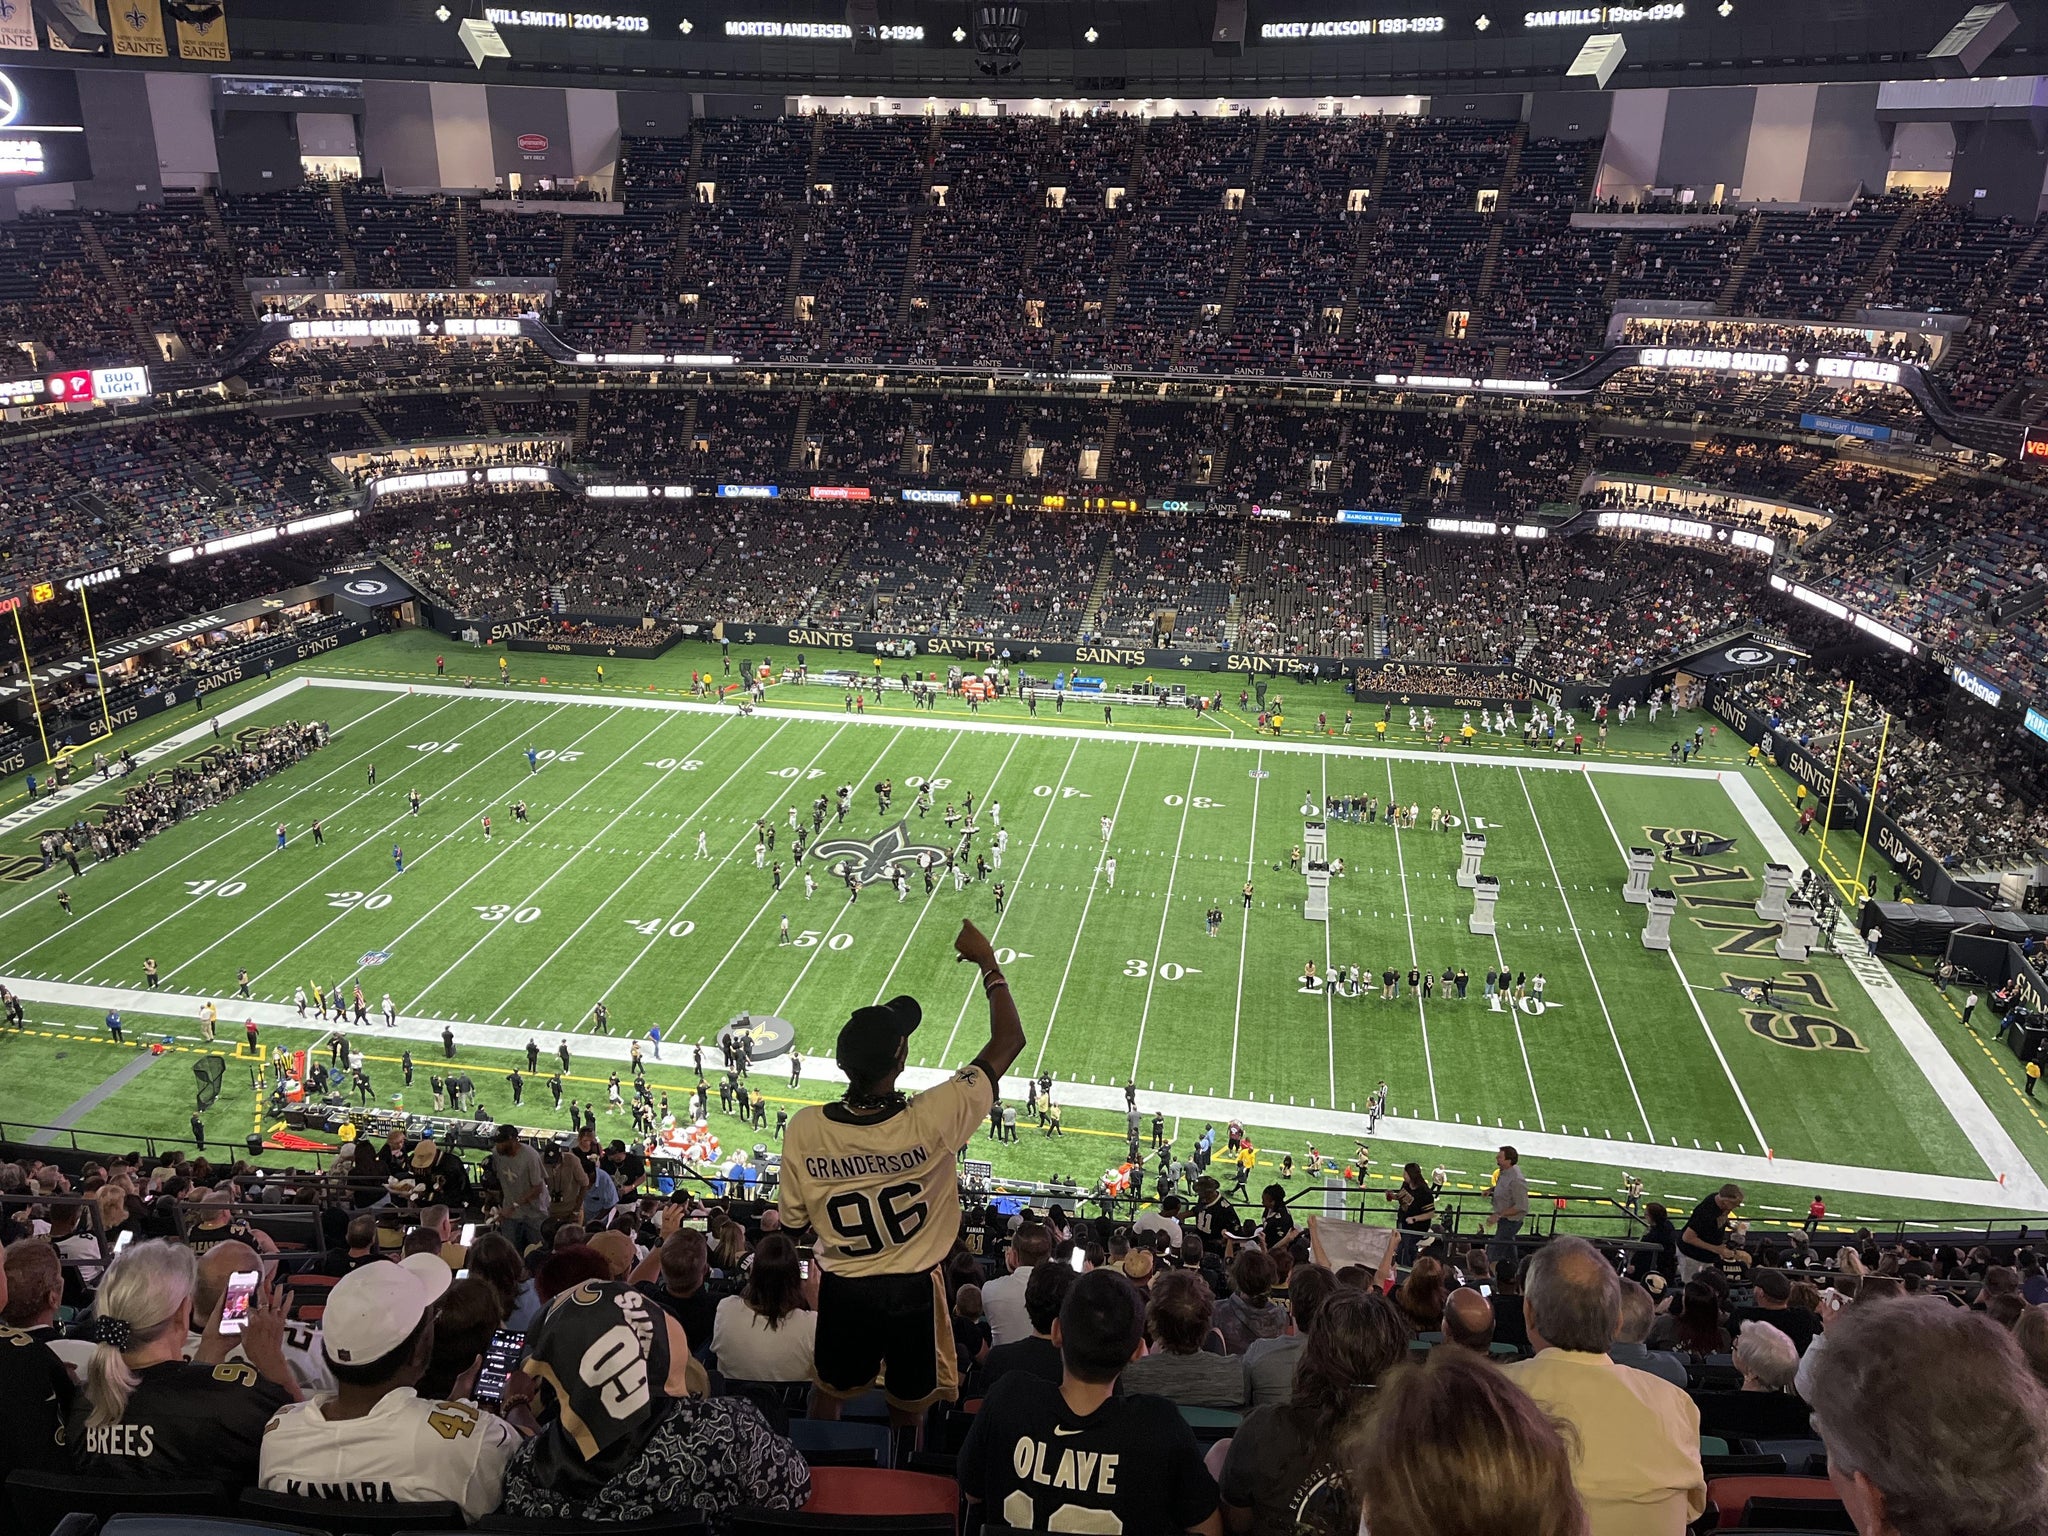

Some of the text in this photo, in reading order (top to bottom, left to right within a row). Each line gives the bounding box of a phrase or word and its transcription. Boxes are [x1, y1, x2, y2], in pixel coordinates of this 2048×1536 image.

[485, 8, 649, 31] WILL SMITH 2004-2013
[1261, 17, 1445, 38] RICKEY JACKSON 1981-1993
[1524, 12, 1556, 27] SAM
[1557, 9, 1600, 25] MILLS
[725, 21, 781, 36] MORTEN
[783, 23, 852, 38] ANDERSEN
[117, 42, 163, 54] SAINTS
[183, 47, 226, 58] SAINTS
[779, 355, 809, 363] SAINTS
[844, 357, 874, 365] SAINTS
[908, 358, 937, 366] SAINTS
[973, 360, 1002, 368] SAINTS
[1103, 363, 1133, 372] SAINTS
[1667, 350, 1731, 369] ORLEANS
[1731, 353, 1789, 373] SAINTS
[1816, 357, 1853, 377] NEW
[104, 371, 134, 383] BUD
[1168, 365, 1198, 374] SAINTS
[1234, 367, 1265, 376] SAINTS
[1301, 370, 1333, 379] SAINTS
[100, 382, 140, 394] LIGHT
[1733, 407, 1765, 418] SAINTS
[1828, 422, 1848, 432] LIGHT
[1850, 426, 1875, 437] LOUNGE
[814, 486, 849, 498] Community
[912, 489, 960, 502] Ochsner
[1162, 501, 1189, 512] COX
[1208, 503, 1238, 513] SAINTS
[125, 556, 153, 570] SAINTS
[65, 567, 121, 591] CAESARS
[98, 614, 226, 659] SUPERDOME
[491, 616, 551, 640] SAIN
[547, 643, 571, 652] SAINTS
[788, 629, 855, 648] SAINTS
[1075, 646, 1145, 667] SAINTS
[1382, 662, 1457, 677] SAS
[198, 666, 243, 694] SAINTS
[1511, 672, 1562, 703] SINTS
[1958, 670, 2001, 708] Ochsner
[1454, 698, 1483, 708] SAINTS
[1712, 694, 1748, 732] SAINTS
[1789, 752, 1832, 796] SAINTS
[185, 878, 248, 897] 10
[328, 890, 394, 910] 20
[478, 903, 542, 923] 30
[635, 917, 696, 937] 40
[792, 929, 855, 951] 50
[1641, 825, 1871, 1053] SAINTS
[1122, 958, 1186, 982] 30
[806, 1145, 928, 1181] GRANDERSON
[826, 1182, 930, 1258] 96
[964, 1233, 985, 1255] 41
[86, 1423, 155, 1458] BREES
[1013, 1435, 1120, 1495] OLAVE
[286, 1479, 396, 1503] KAMARA
[1289, 1468, 1324, 1510] EXPLORE
